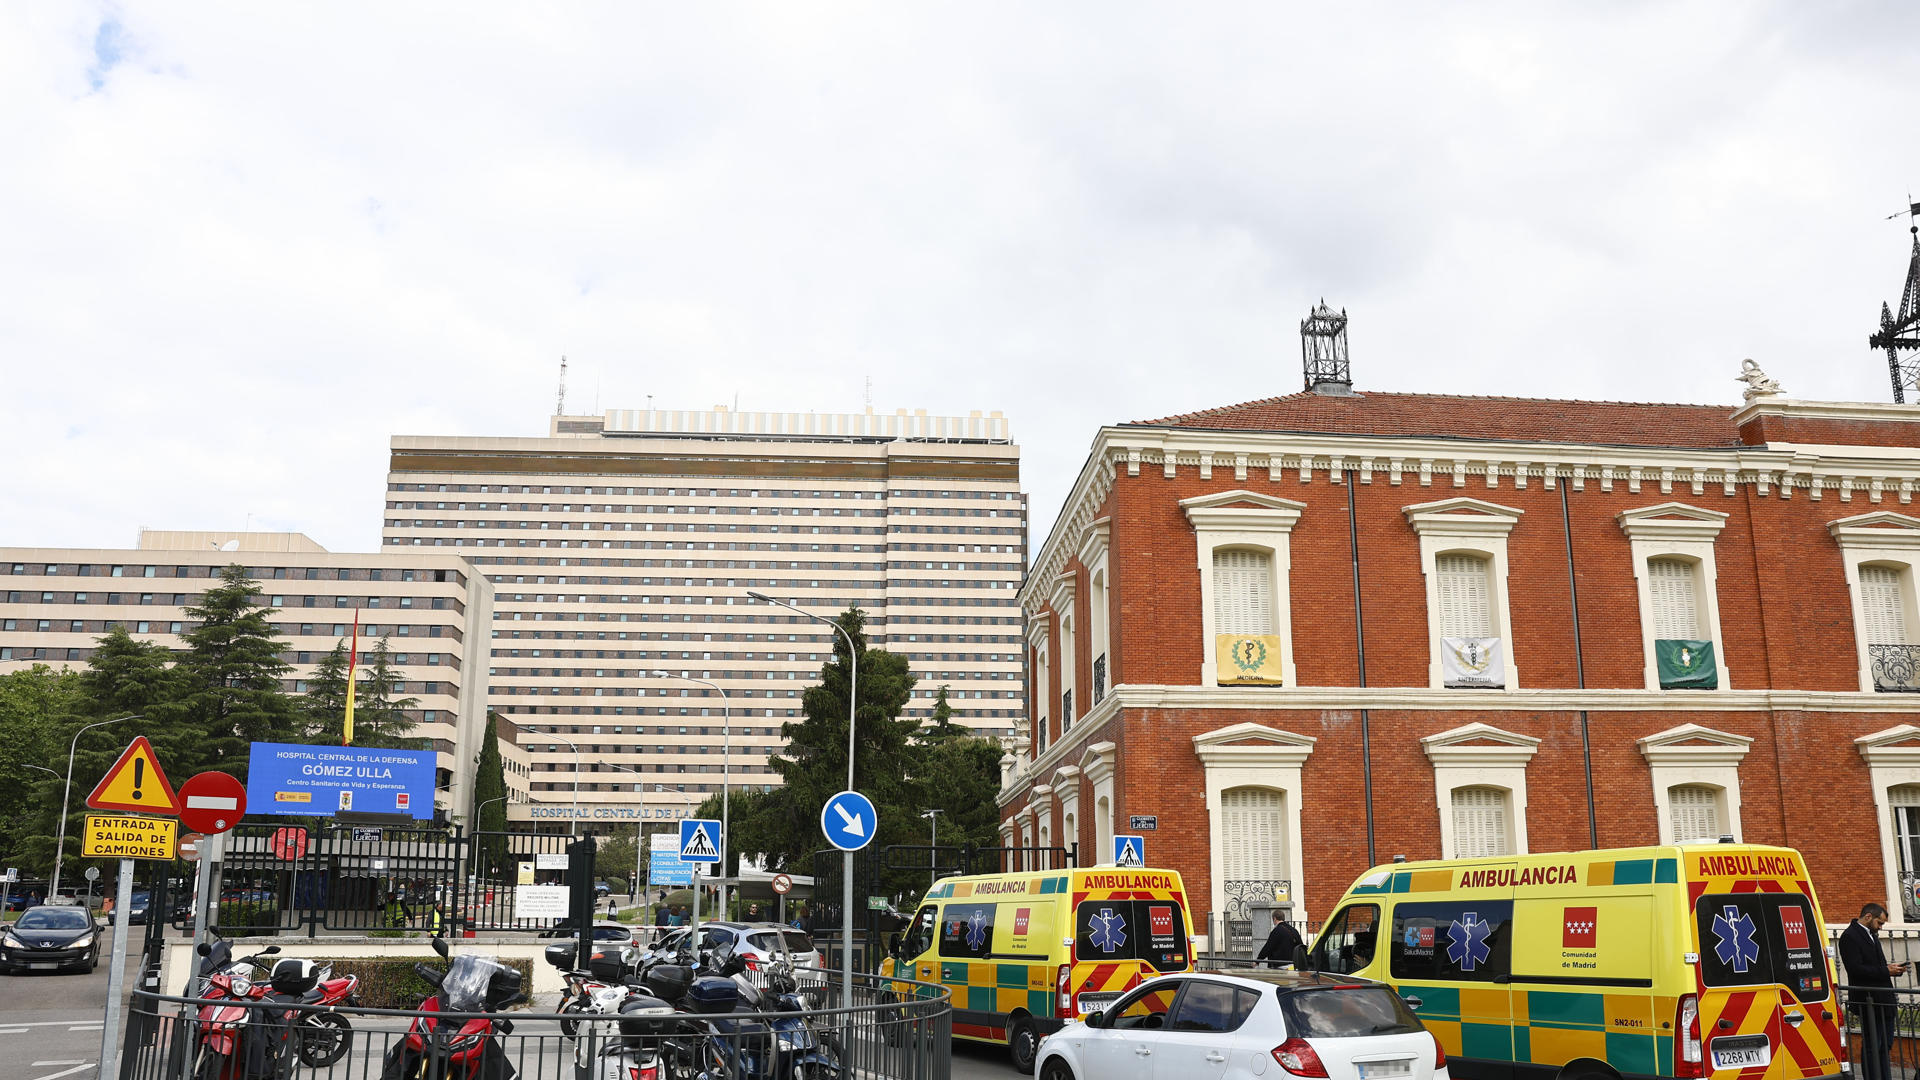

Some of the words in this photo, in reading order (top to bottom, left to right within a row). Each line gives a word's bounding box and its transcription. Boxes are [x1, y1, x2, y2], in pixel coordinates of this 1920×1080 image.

[276, 752, 316, 760] HOSPITAL
[318, 753, 355, 762] CENTRAL
[357, 755, 368, 763] DE
[381, 756, 418, 765] DEFENSA
[302, 762, 353, 777] GÓMEZ
[356, 767, 392, 779] ULLA
[286, 778, 310, 786] Centro
[311, 780, 340, 788] Sanitario
[372, 782, 405, 790] Esperanza
[531, 808, 591, 818] HOSPITAL
[594, 808, 651, 819] CENTRAL
[655, 808, 672, 819] DE
[675, 809, 690, 819] LA
[93, 818, 154, 830] ENTRADA
[163, 823, 170, 832] Y
[96, 832, 143, 842] SALIDA
[151, 835, 166, 844] DE
[94, 845, 165, 856] CAMIONES
[1699, 856, 1798, 876] AMBULANCIA
[1084, 875, 1172, 889] AMBULANCIA
[1459, 865, 1577, 888] AMBULANCIA
[975, 881, 1026, 895] AMBULANCIA
[1404, 948, 1434, 956] SaludMadrid
[1087, 1002, 1104, 1011] 5231
[1614, 1018, 1643, 1027] SN2-011
[1720, 1051, 1744, 1065] 2268
[1745, 1050, 1760, 1062] MTY
[1819, 1057, 1836, 1066] SN2-011
